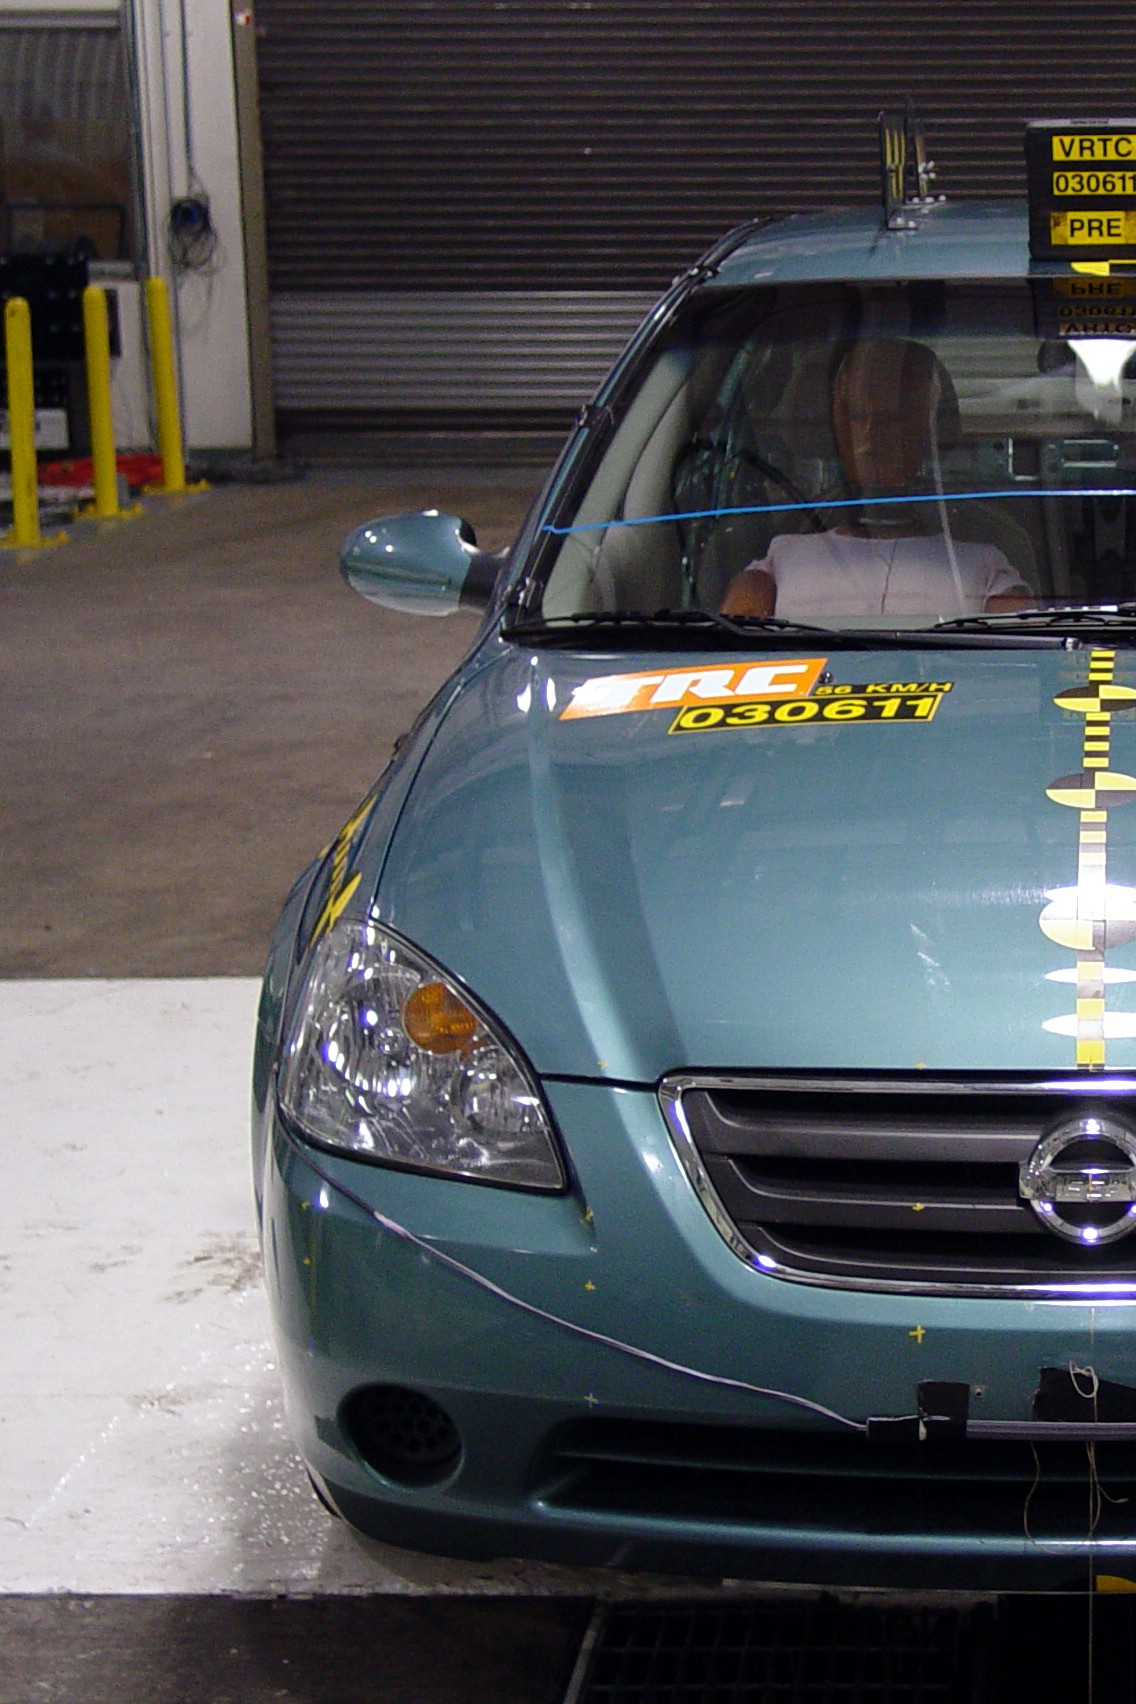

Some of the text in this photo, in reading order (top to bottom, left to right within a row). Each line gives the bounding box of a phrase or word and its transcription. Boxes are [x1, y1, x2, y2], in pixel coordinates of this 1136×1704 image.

[1059, 137, 1133, 158] VRTC
[1069, 218, 1122, 238] PRE
[814, 682, 952, 696] 56 KM/H
[679, 697, 935, 729] 030611
